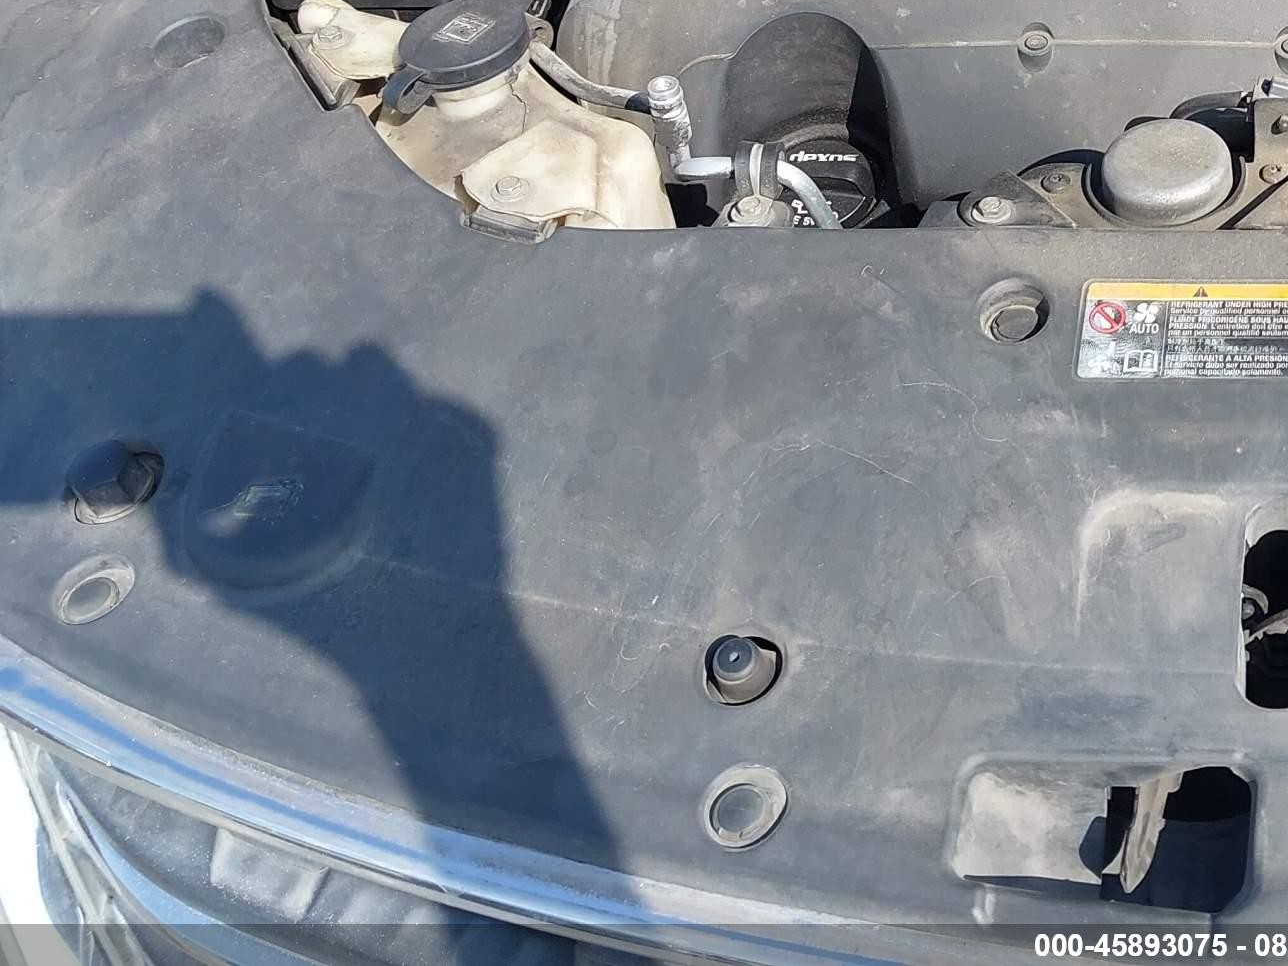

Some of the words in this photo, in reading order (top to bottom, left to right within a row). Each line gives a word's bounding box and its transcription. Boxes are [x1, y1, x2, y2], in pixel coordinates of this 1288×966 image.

[1225, 300, 1252, 309] UNDER
[1253, 301, 1272, 309] HIGH
[1243, 309, 1281, 317] personnel
[1250, 316, 1272, 324] SOUS
[1129, 323, 1160, 334] AUTO
[1225, 354, 1234, 362] A
[1234, 354, 1254, 362] ALTA
[1275, 362, 1288, 370] por
